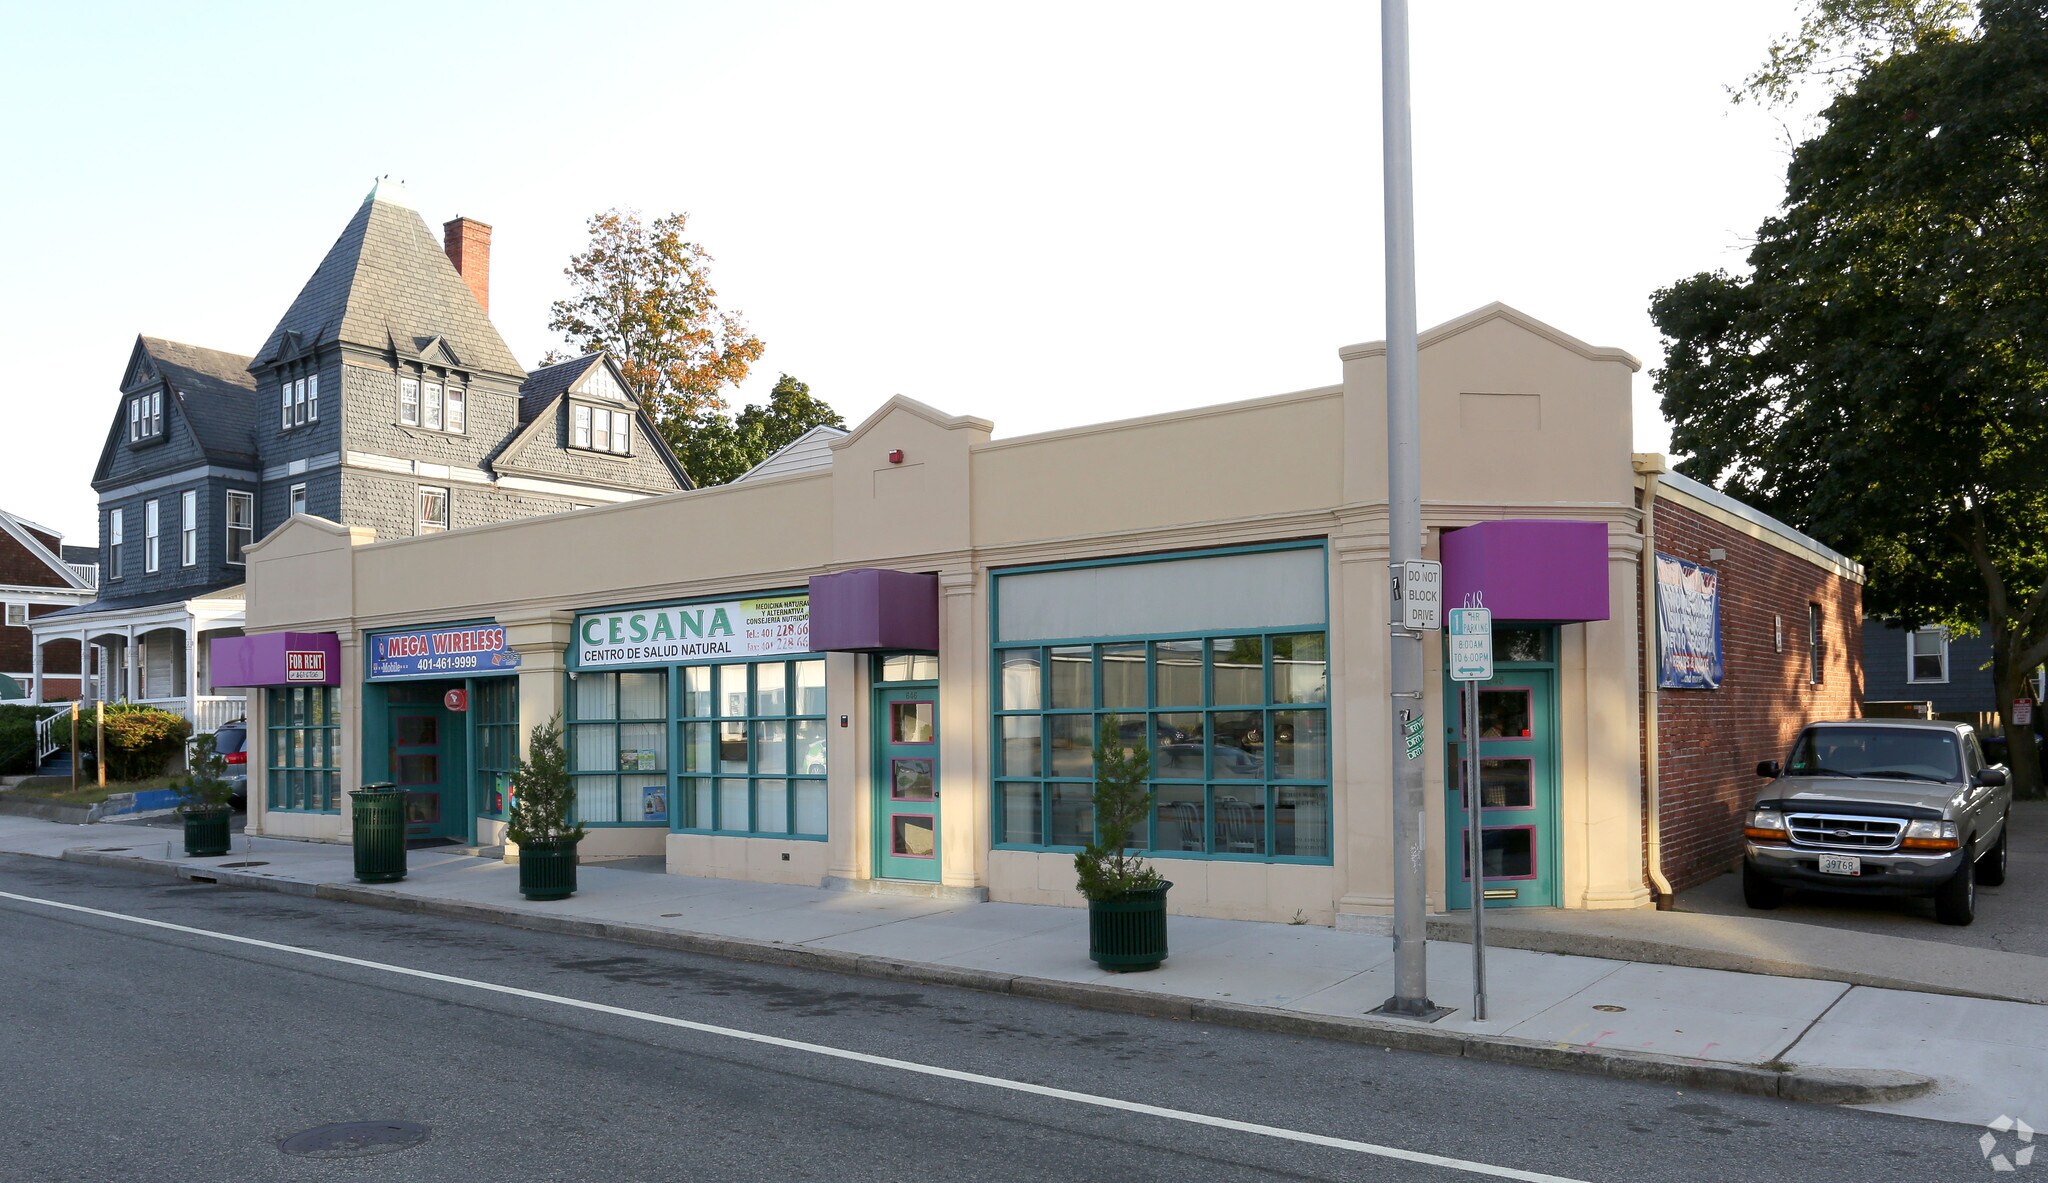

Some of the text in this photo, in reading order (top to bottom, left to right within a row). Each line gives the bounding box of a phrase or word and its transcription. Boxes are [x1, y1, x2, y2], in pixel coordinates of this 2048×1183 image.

[1409, 571, 1438, 582] DO NOT
[1409, 590, 1437, 602] BLOCK
[755, 600, 809, 610] MEDICINA NATURA
[767, 608, 804, 616] ALTERNATIVA
[1412, 609, 1434, 621] DRIVE
[582, 607, 735, 646] CESANA
[746, 616, 780, 625] CONSEJERIA
[1455, 613, 1480, 631] 1 HR
[761, 628, 773, 638] 401
[1463, 624, 1489, 633] PARKING
[387, 628, 504, 658] MEGA WIRELESS
[1458, 640, 1483, 649] 8:00AM
[584, 641, 732, 661] CENTRO DE SALUD NATURAL
[289, 653, 322, 669] FOR RENT
[417, 656, 477, 671] 401-461-9999
[1455, 653, 1489, 662] TO 6:00PM
[1825, 859, 1854, 871] 39768
